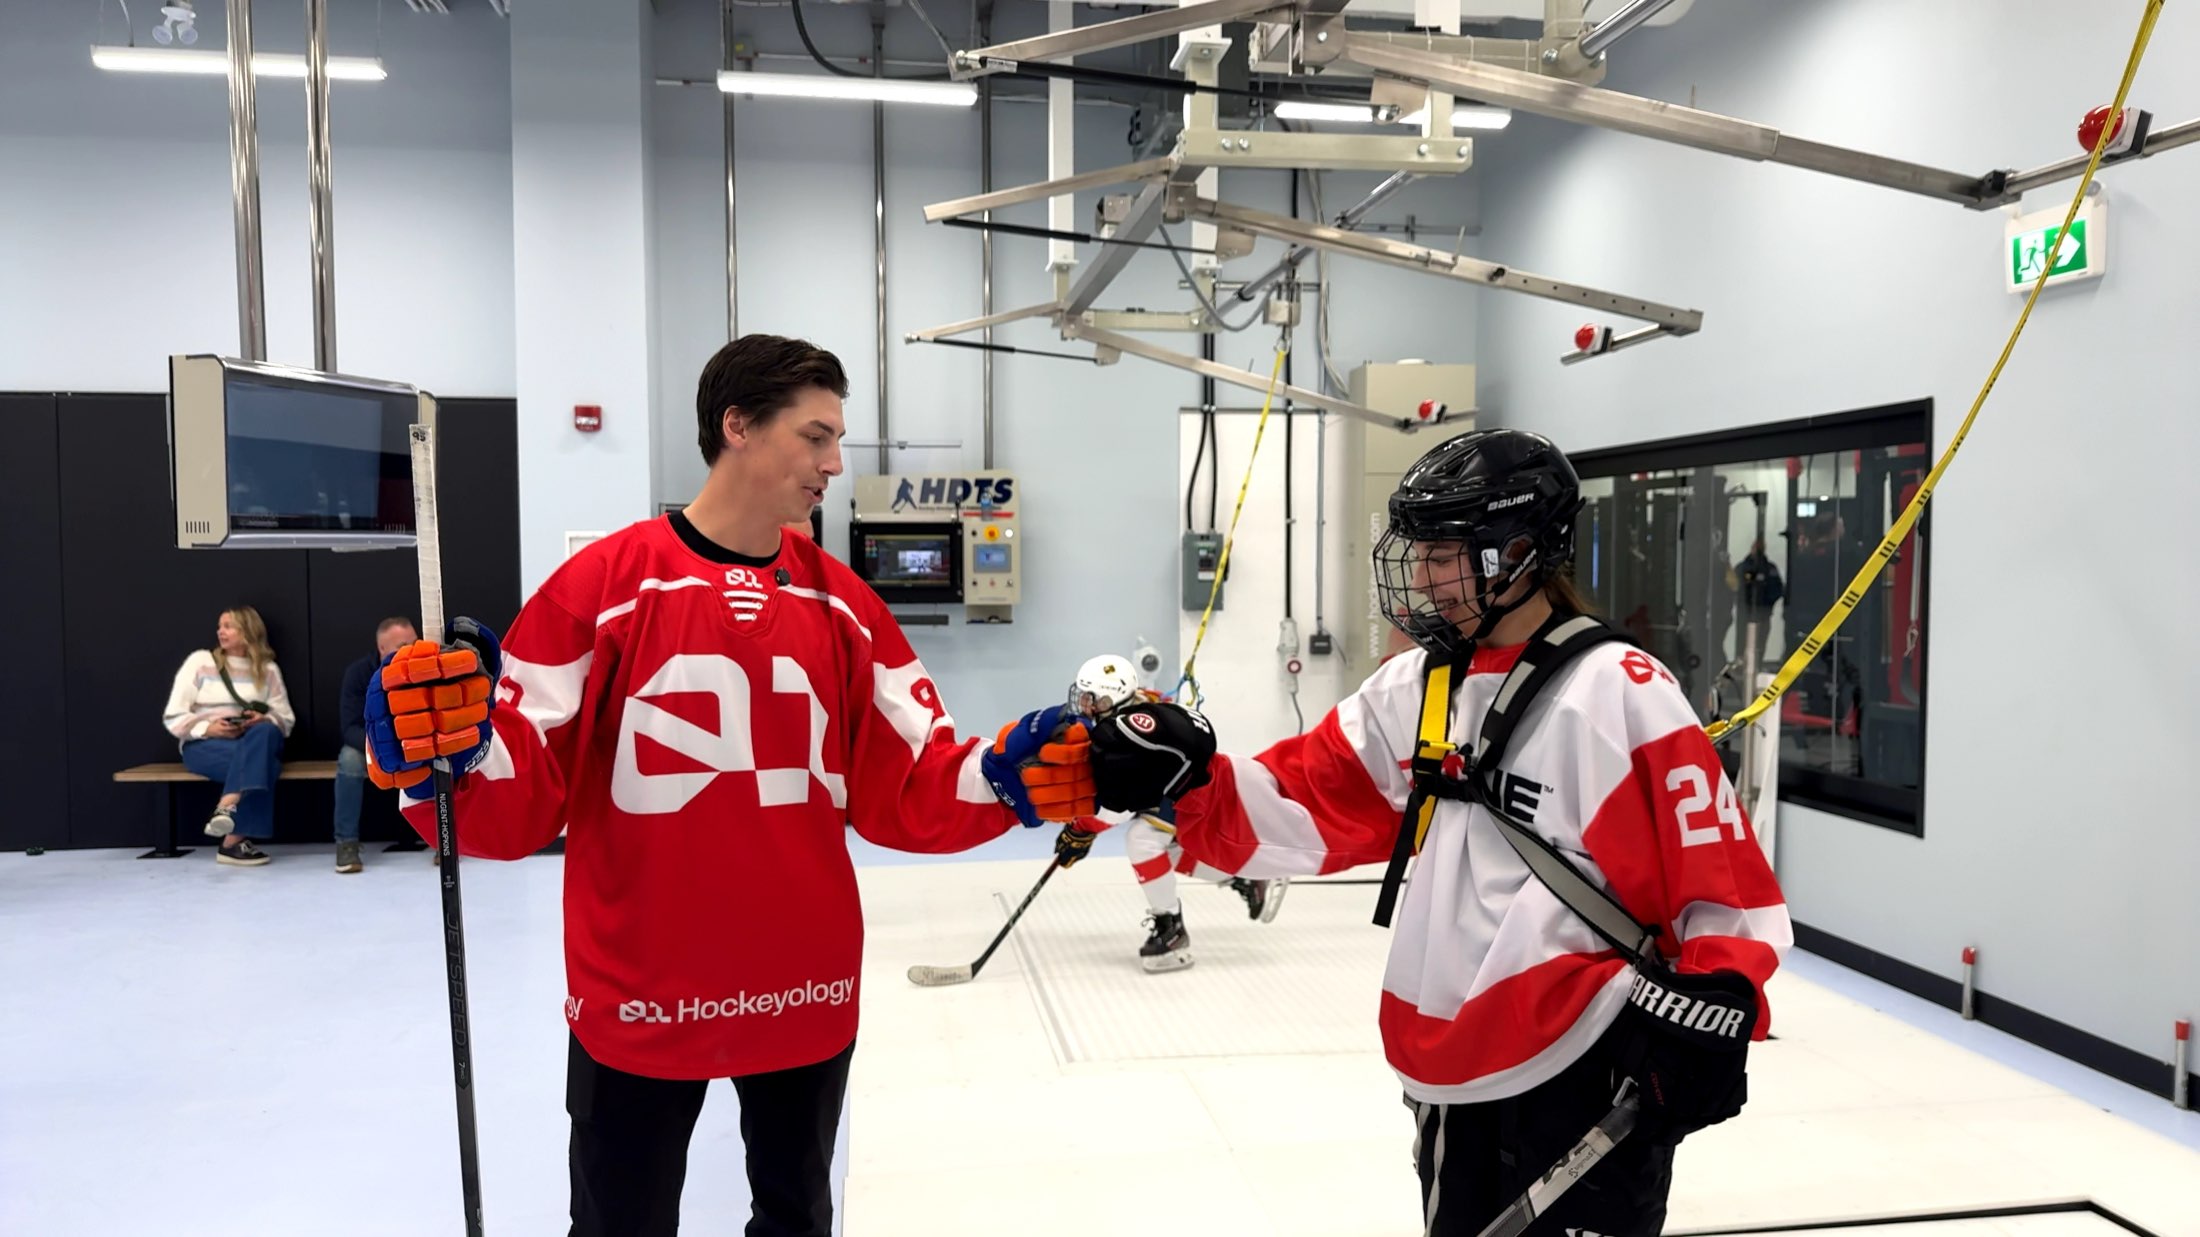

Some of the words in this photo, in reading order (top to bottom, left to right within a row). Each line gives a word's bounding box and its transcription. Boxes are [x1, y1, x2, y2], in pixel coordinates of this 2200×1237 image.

[919, 478, 1014, 504] HDTS
[1487, 493, 1535, 511] BAUER
[440, 793, 450, 856] NUGENT-HOPKINS
[1665, 764, 1746, 848] 24
[447, 912, 468, 1046] JETSPEED
[677, 976, 855, 1023] Hockeyology
[1628, 974, 1745, 1038] ARRIOR
